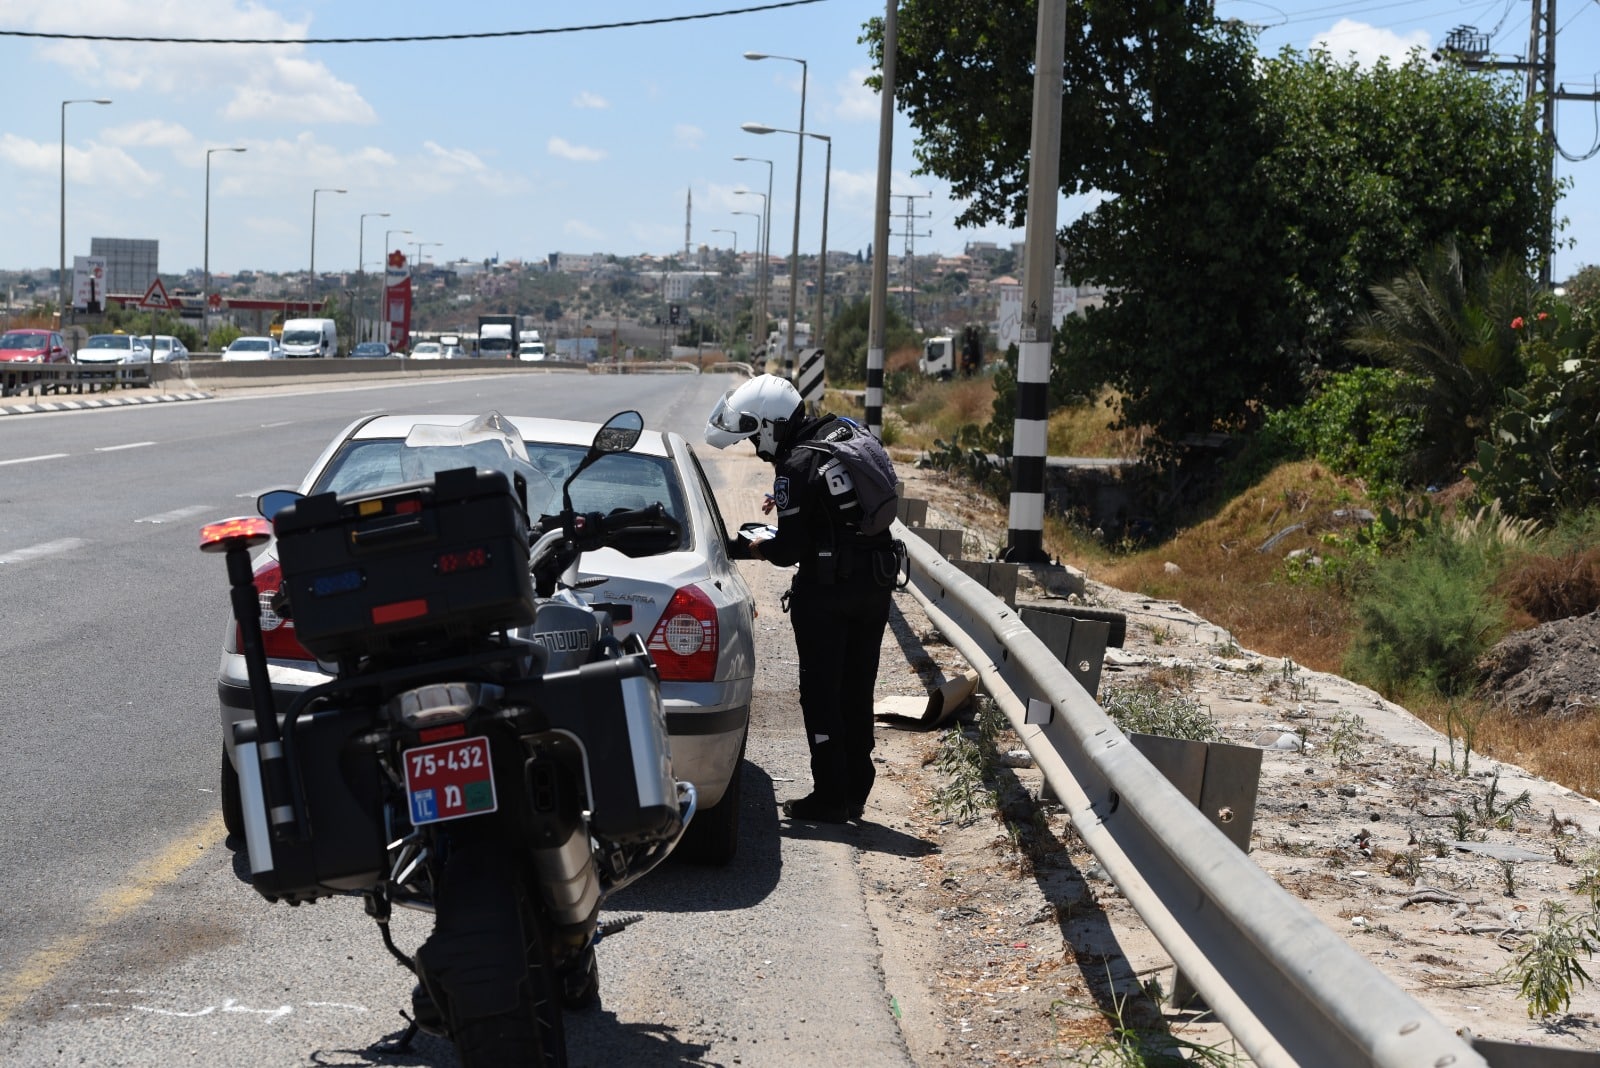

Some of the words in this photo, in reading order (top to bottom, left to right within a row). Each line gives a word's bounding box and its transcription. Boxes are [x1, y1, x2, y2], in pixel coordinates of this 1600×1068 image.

[533, 629, 590, 653] משטרה
[411, 746, 484, 778] 75-432
[444, 785, 462, 808] מ
